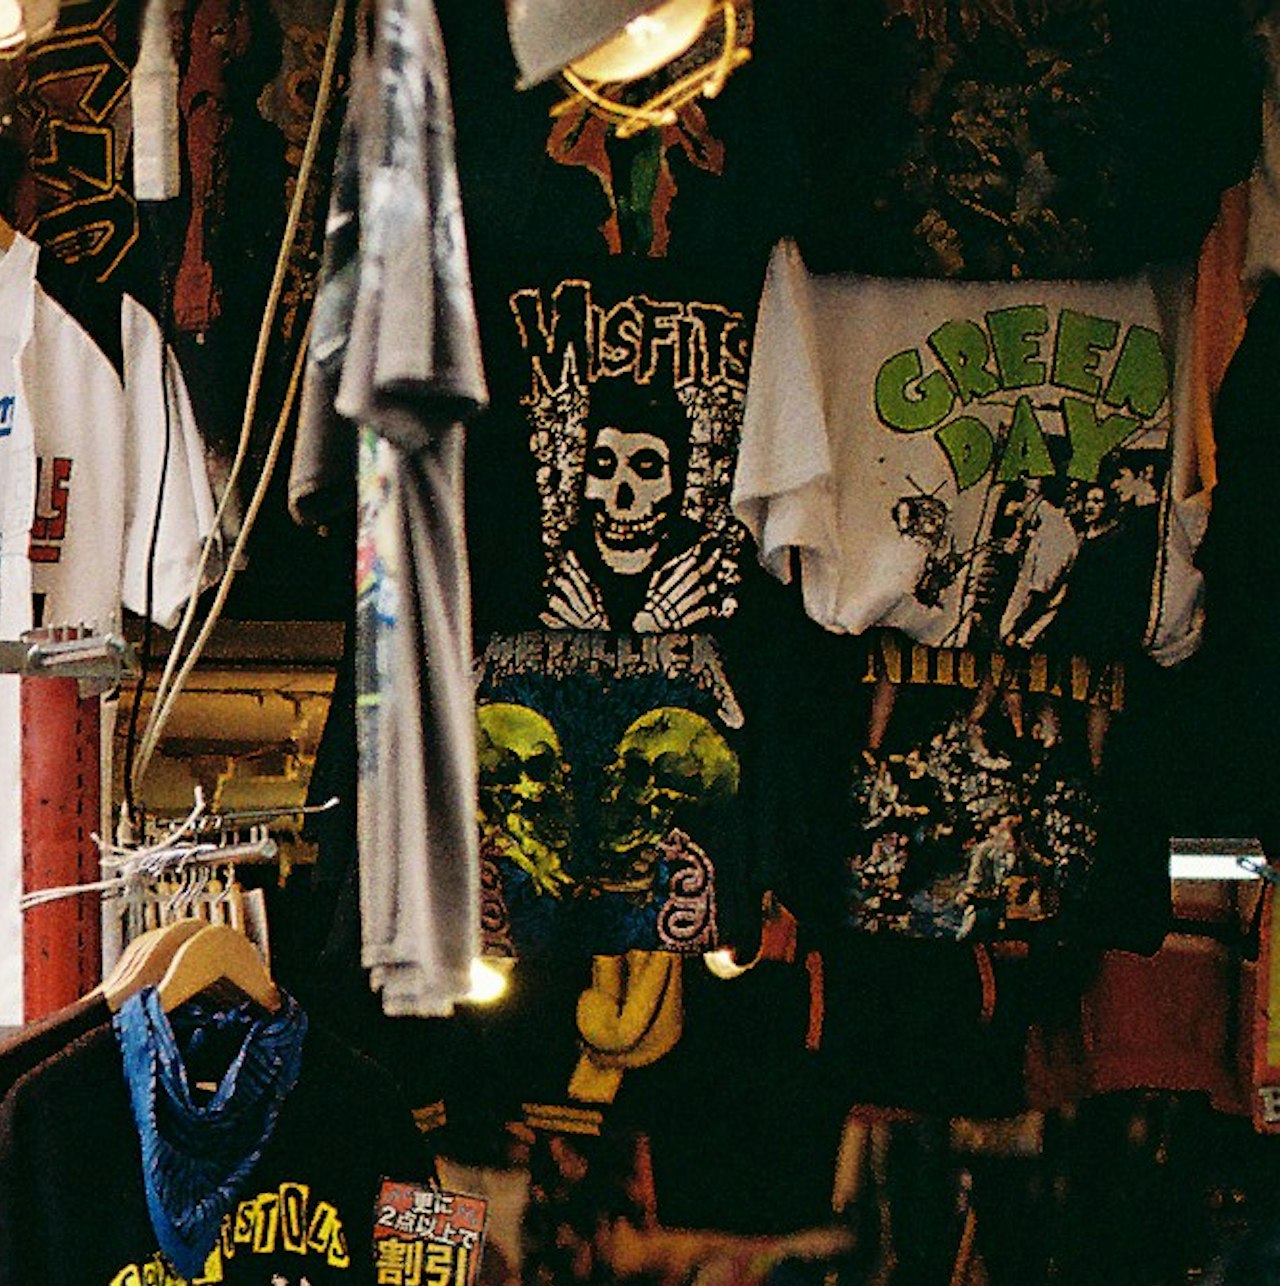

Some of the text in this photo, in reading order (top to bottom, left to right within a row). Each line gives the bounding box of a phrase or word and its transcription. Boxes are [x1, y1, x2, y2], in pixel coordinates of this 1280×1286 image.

[509, 277, 748, 398] MISFITS
[875, 304, 1171, 424] GREEN
[934, 396, 1143, 495] DAY
[378, 1204, 479, 1250] 2点以上で
